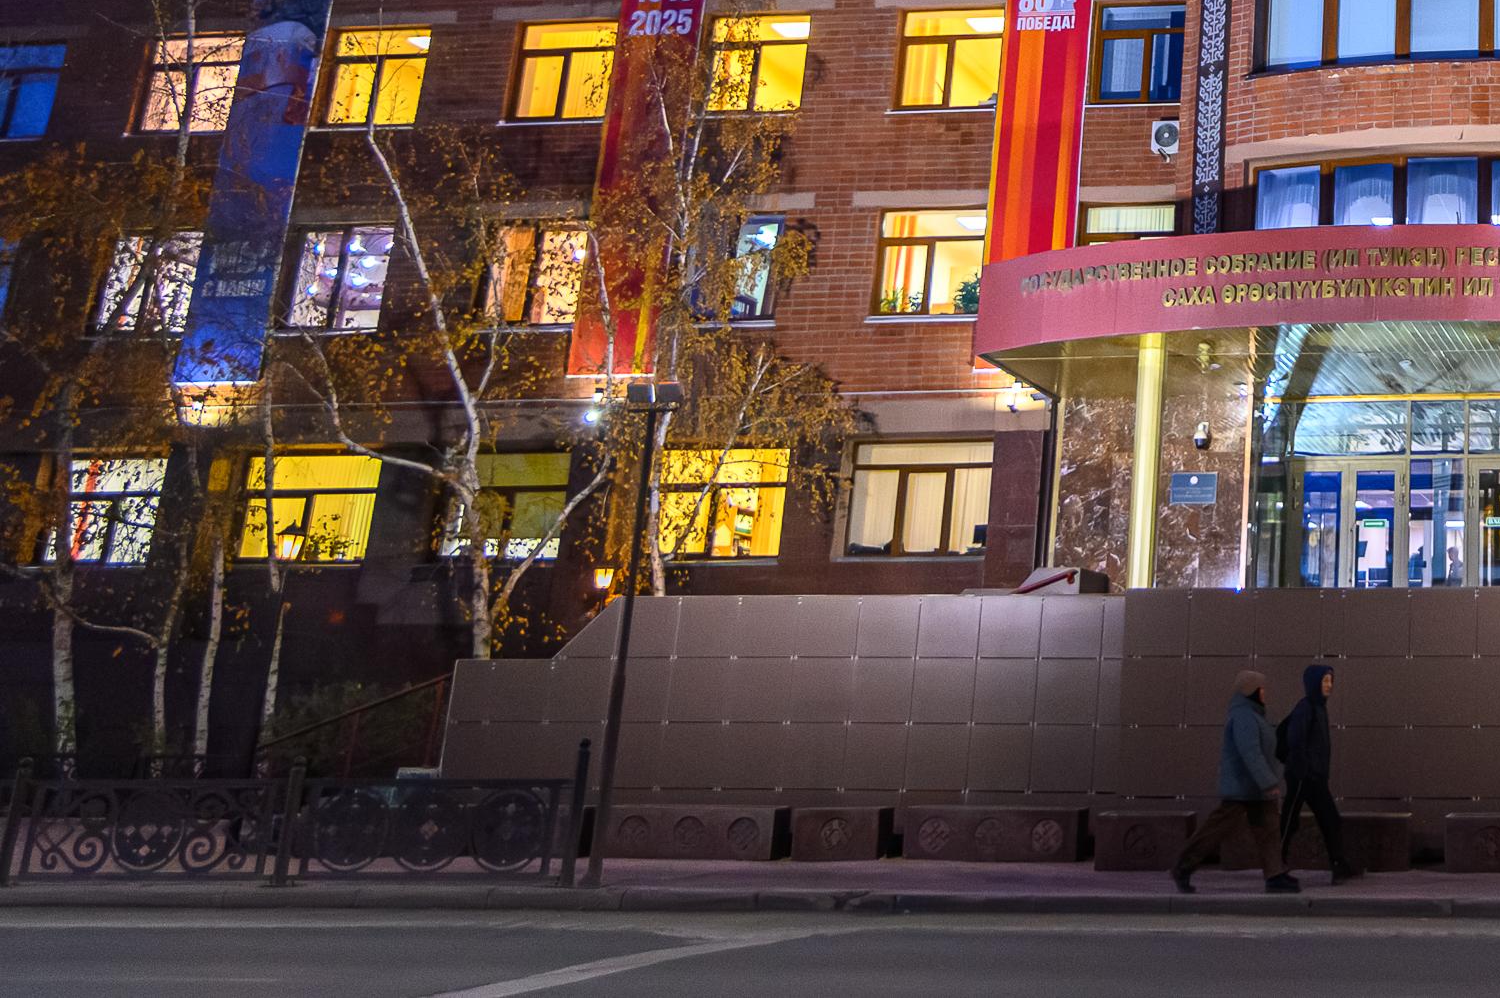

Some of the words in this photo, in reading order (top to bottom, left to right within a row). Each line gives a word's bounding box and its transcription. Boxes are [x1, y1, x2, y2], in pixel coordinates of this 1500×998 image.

[628, 8, 694, 36] 2025
[1017, 15, 1076, 32] ПОБЕДА!
[1020, 257, 1199, 296] ГОСУДАРСТВЕННОЕ
[1204, 250, 1317, 275] СОБРАНИЕ
[1321, 248, 1360, 273] (ИЛ
[1366, 246, 1448, 271] ТУМЭН)
[1162, 285, 1217, 308] САХА
[1462, 277, 1494, 299] ИЛ
